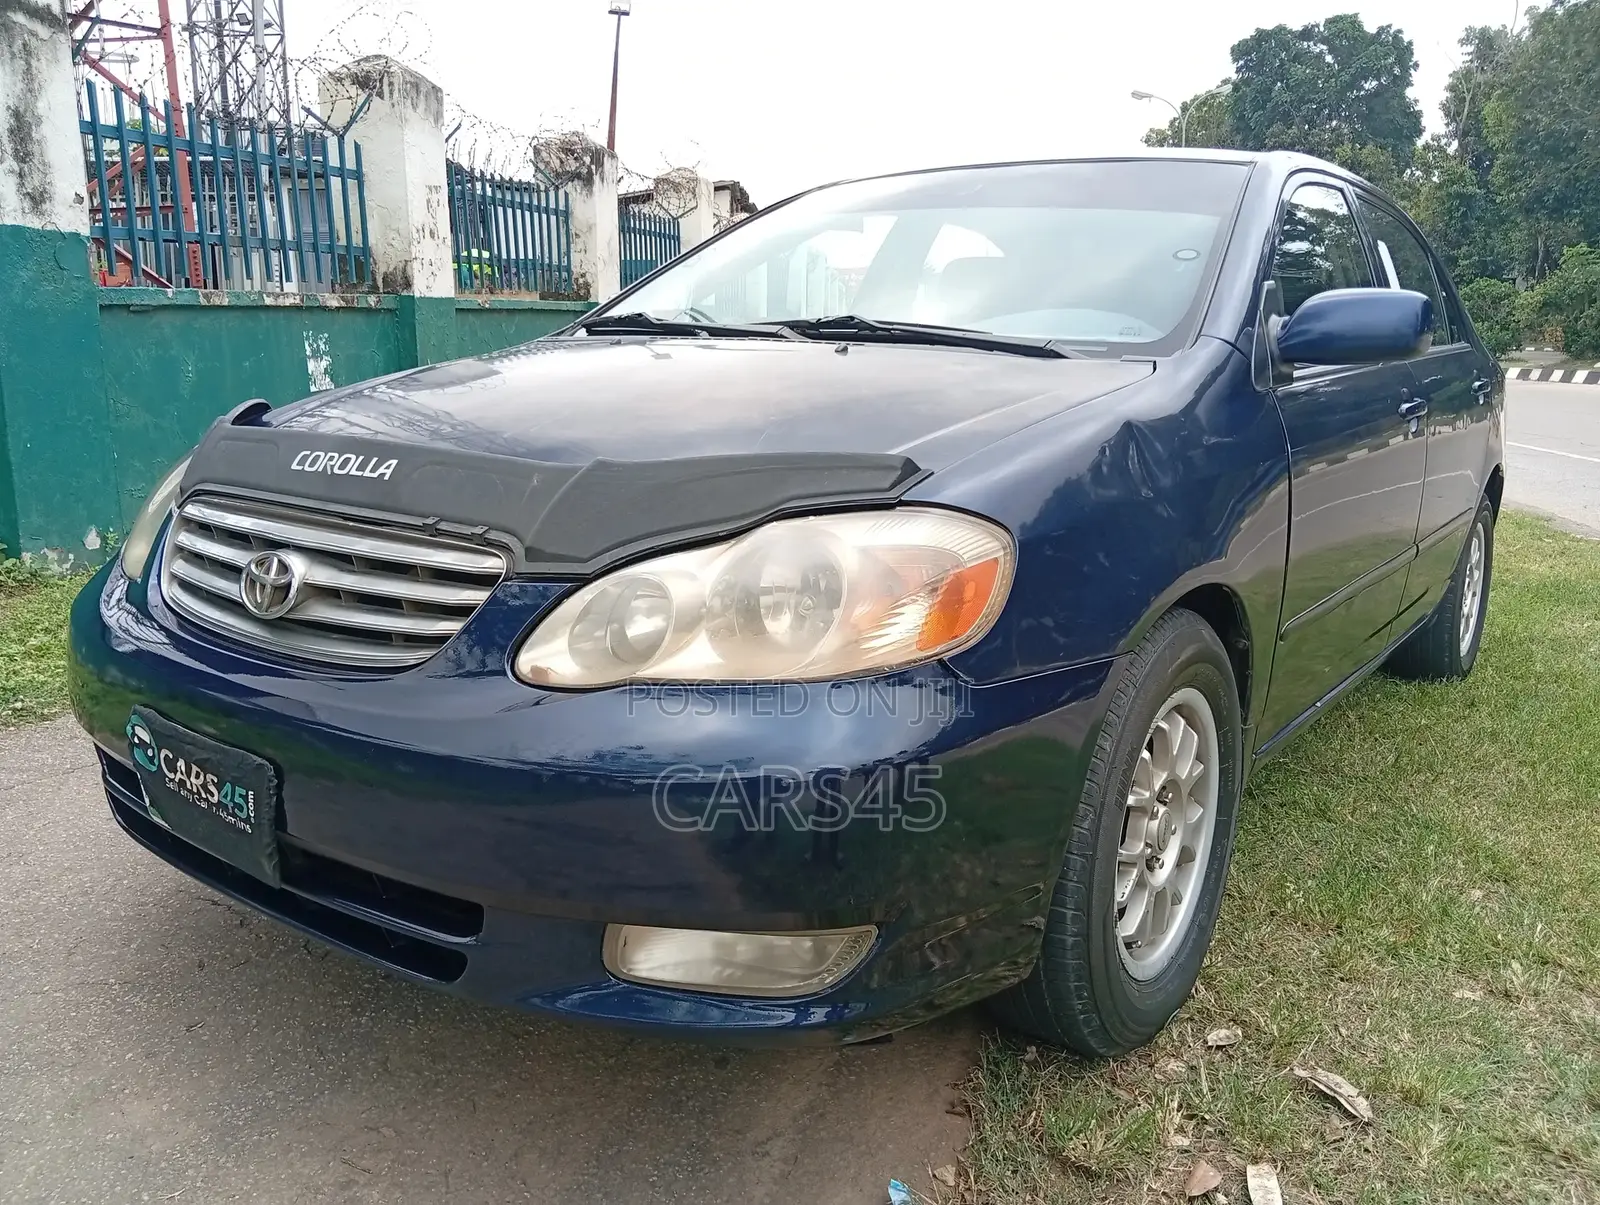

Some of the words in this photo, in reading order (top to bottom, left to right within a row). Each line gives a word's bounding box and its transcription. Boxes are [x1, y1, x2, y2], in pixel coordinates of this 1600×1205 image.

[290, 450, 399, 481] COROLLA
[160, 748, 247, 819] CARS45
[165, 777, 178, 792] Sell
